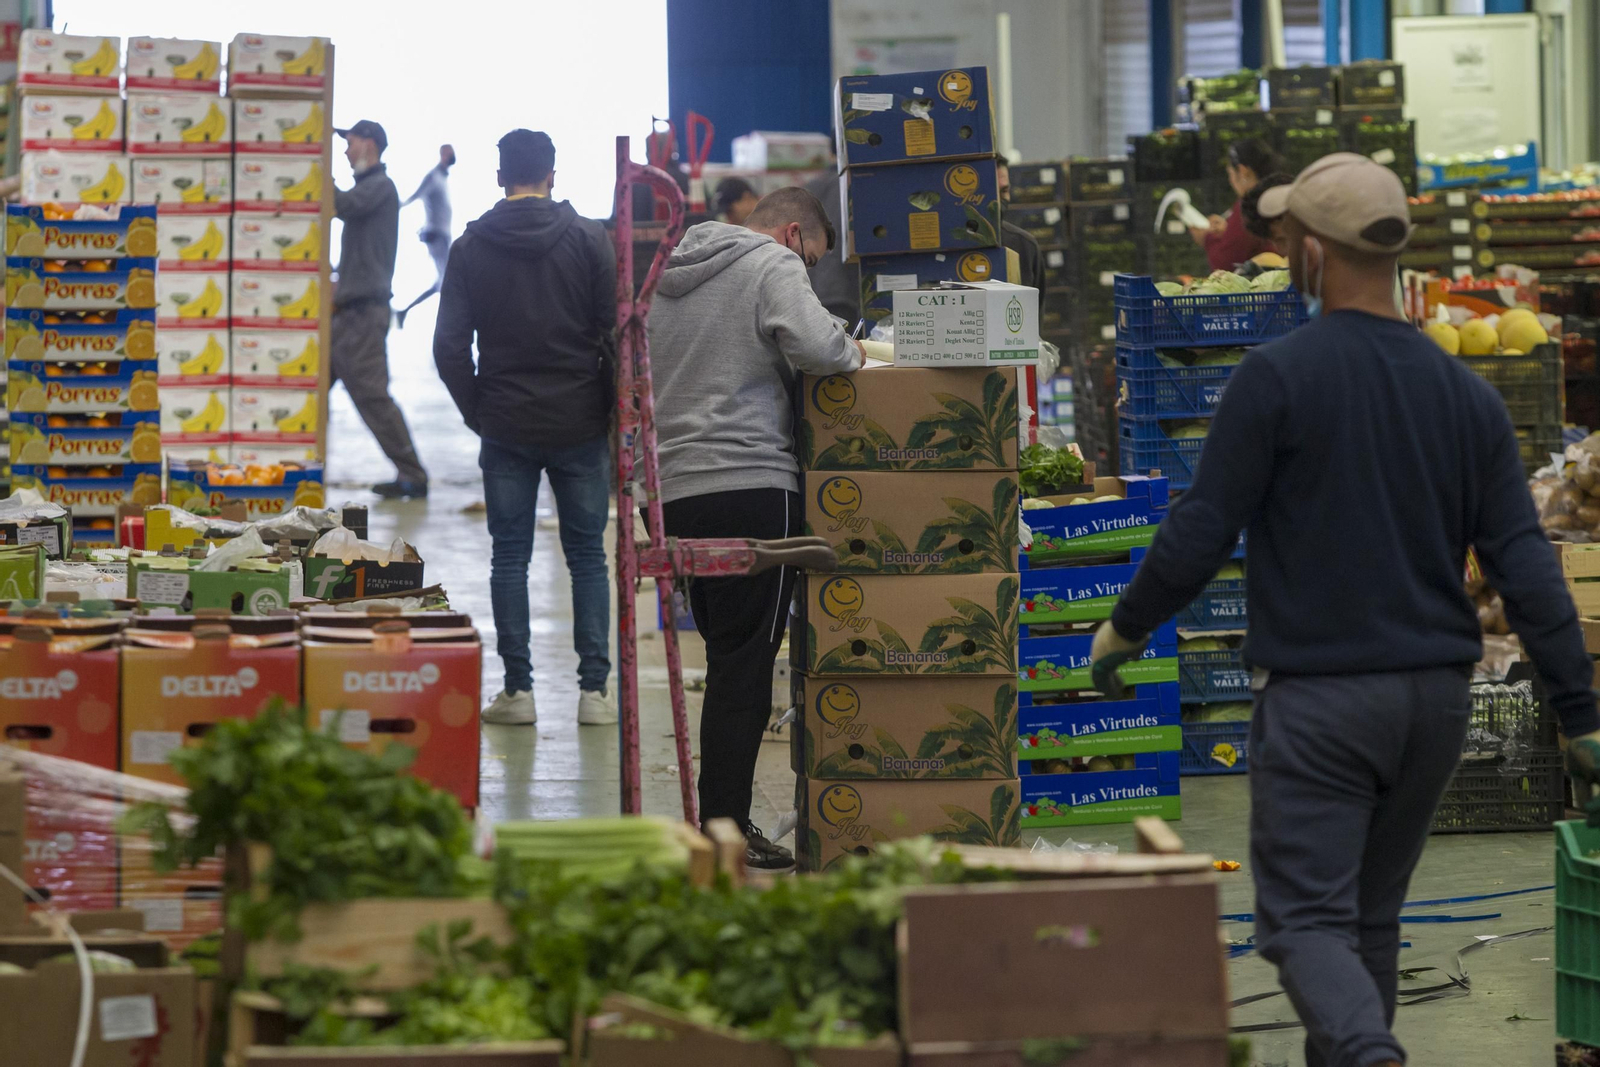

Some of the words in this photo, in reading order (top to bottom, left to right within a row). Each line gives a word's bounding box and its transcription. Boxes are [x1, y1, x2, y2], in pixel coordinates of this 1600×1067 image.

[950, 96, 978, 112] Joy
[954, 189, 986, 206] Joy
[44, 226, 118, 248] Porras
[44, 277, 118, 298] Porras
[918, 295, 948, 306] CAT
[960, 295, 966, 305] I
[1008, 308, 1020, 326] HSB
[1203, 322, 1230, 330] VALE
[44, 329, 118, 350] Porras
[46, 382, 121, 404] Porras
[1205, 395, 1222, 403] VA
[822, 407, 864, 431] Joy
[50, 433, 124, 455] Porras
[879, 446, 939, 461] Bananas
[50, 484, 125, 506] Porras
[209, 491, 285, 513] Pras
[827, 509, 870, 533] Joy
[1064, 524, 1089, 539] Las
[1091, 514, 1149, 532] Virtudes
[884, 550, 944, 564] Bananas
[1067, 587, 1092, 601] Las
[1094, 581, 1131, 596] Virtu
[829, 609, 871, 633] Joy
[1211, 607, 1238, 616] VALE
[886, 650, 948, 665] Bananas
[1070, 654, 1093, 668] Las
[0, 678, 62, 699] ELTA
[160, 676, 242, 697] DELTA
[343, 671, 424, 693] DELTA
[1214, 678, 1240, 687] VALE
[1244, 678, 1250, 686] 2
[826, 716, 868, 740] Joy
[1071, 722, 1096, 736] Las
[1100, 714, 1158, 731] Virtudes
[883, 756, 944, 771] Bananas
[1071, 792, 1096, 806] Las
[1100, 784, 1158, 800] Virtudes
[827, 817, 870, 840] Joy
